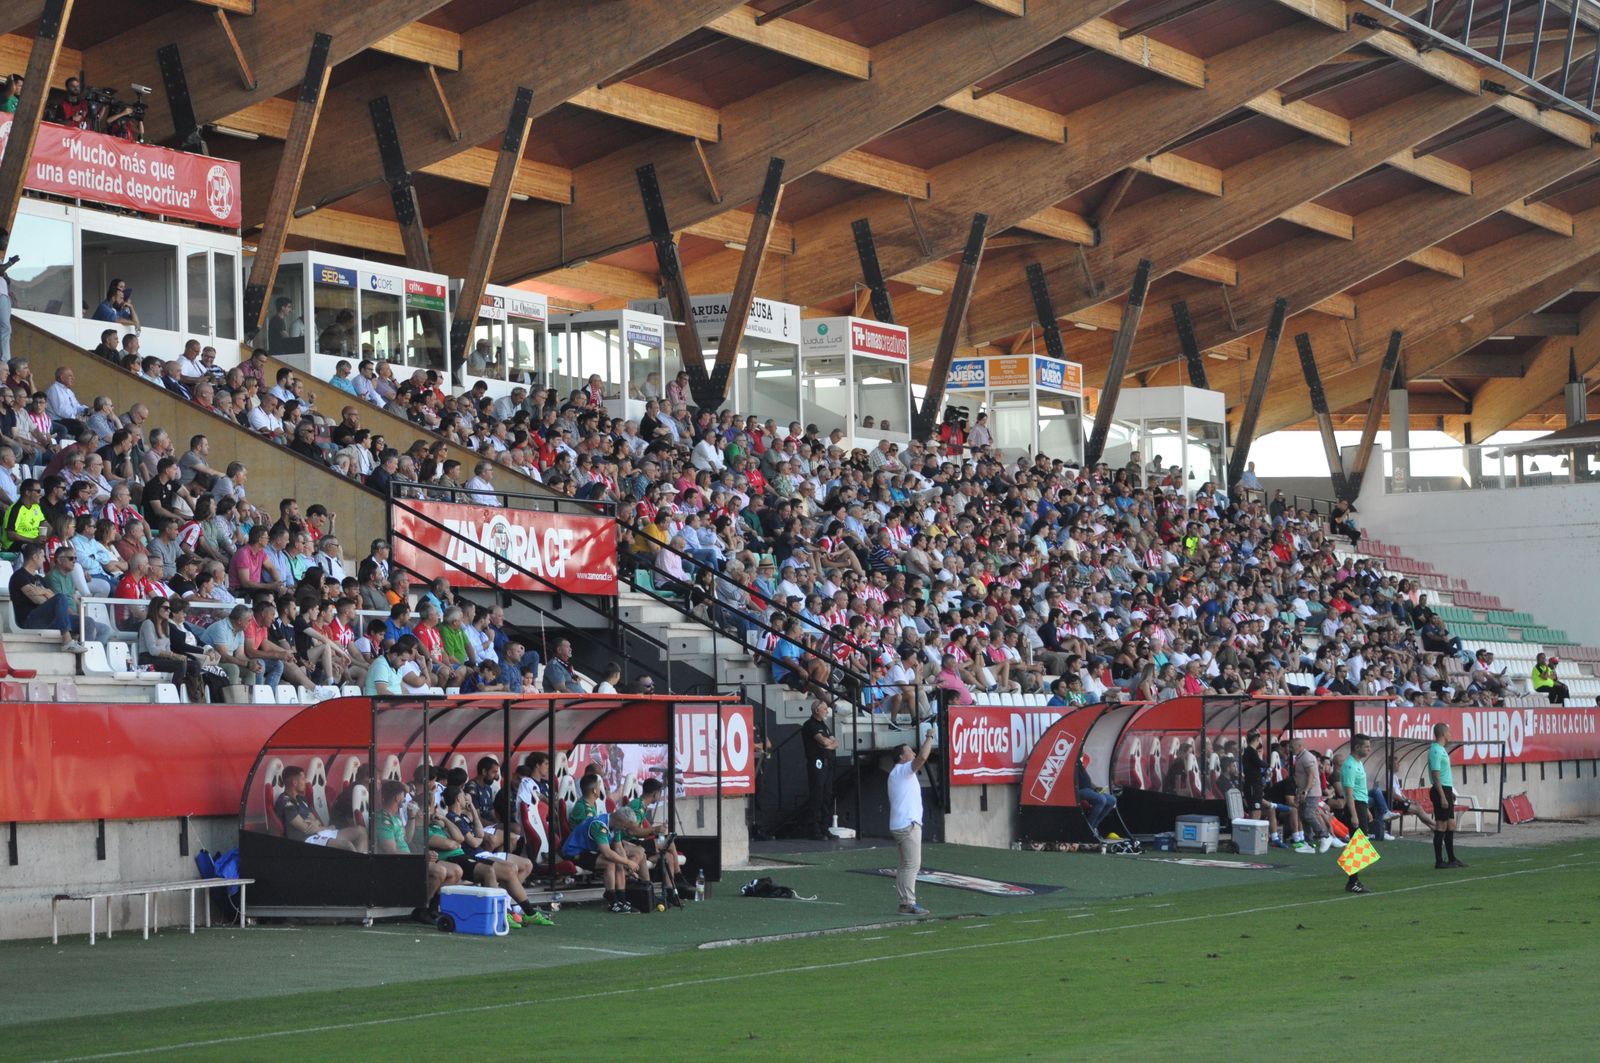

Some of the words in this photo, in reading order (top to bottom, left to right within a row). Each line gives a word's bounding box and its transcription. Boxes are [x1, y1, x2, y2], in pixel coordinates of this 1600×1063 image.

[36, 163, 63, 184] una
[68, 167, 123, 195] entidad
[120, 152, 147, 175] más
[150, 160, 175, 181] que
[378, 279, 393, 291] COPE
[1041, 367, 1062, 385] DUERO
[443, 514, 544, 584] ZAMORA
[544, 527, 573, 578] CF
[674, 712, 749, 772] UERO
[952, 715, 1009, 765] Gráficas
[1462, 710, 1524, 760] DUERO
[1533, 708, 1596, 735] FABRICACIÓN
